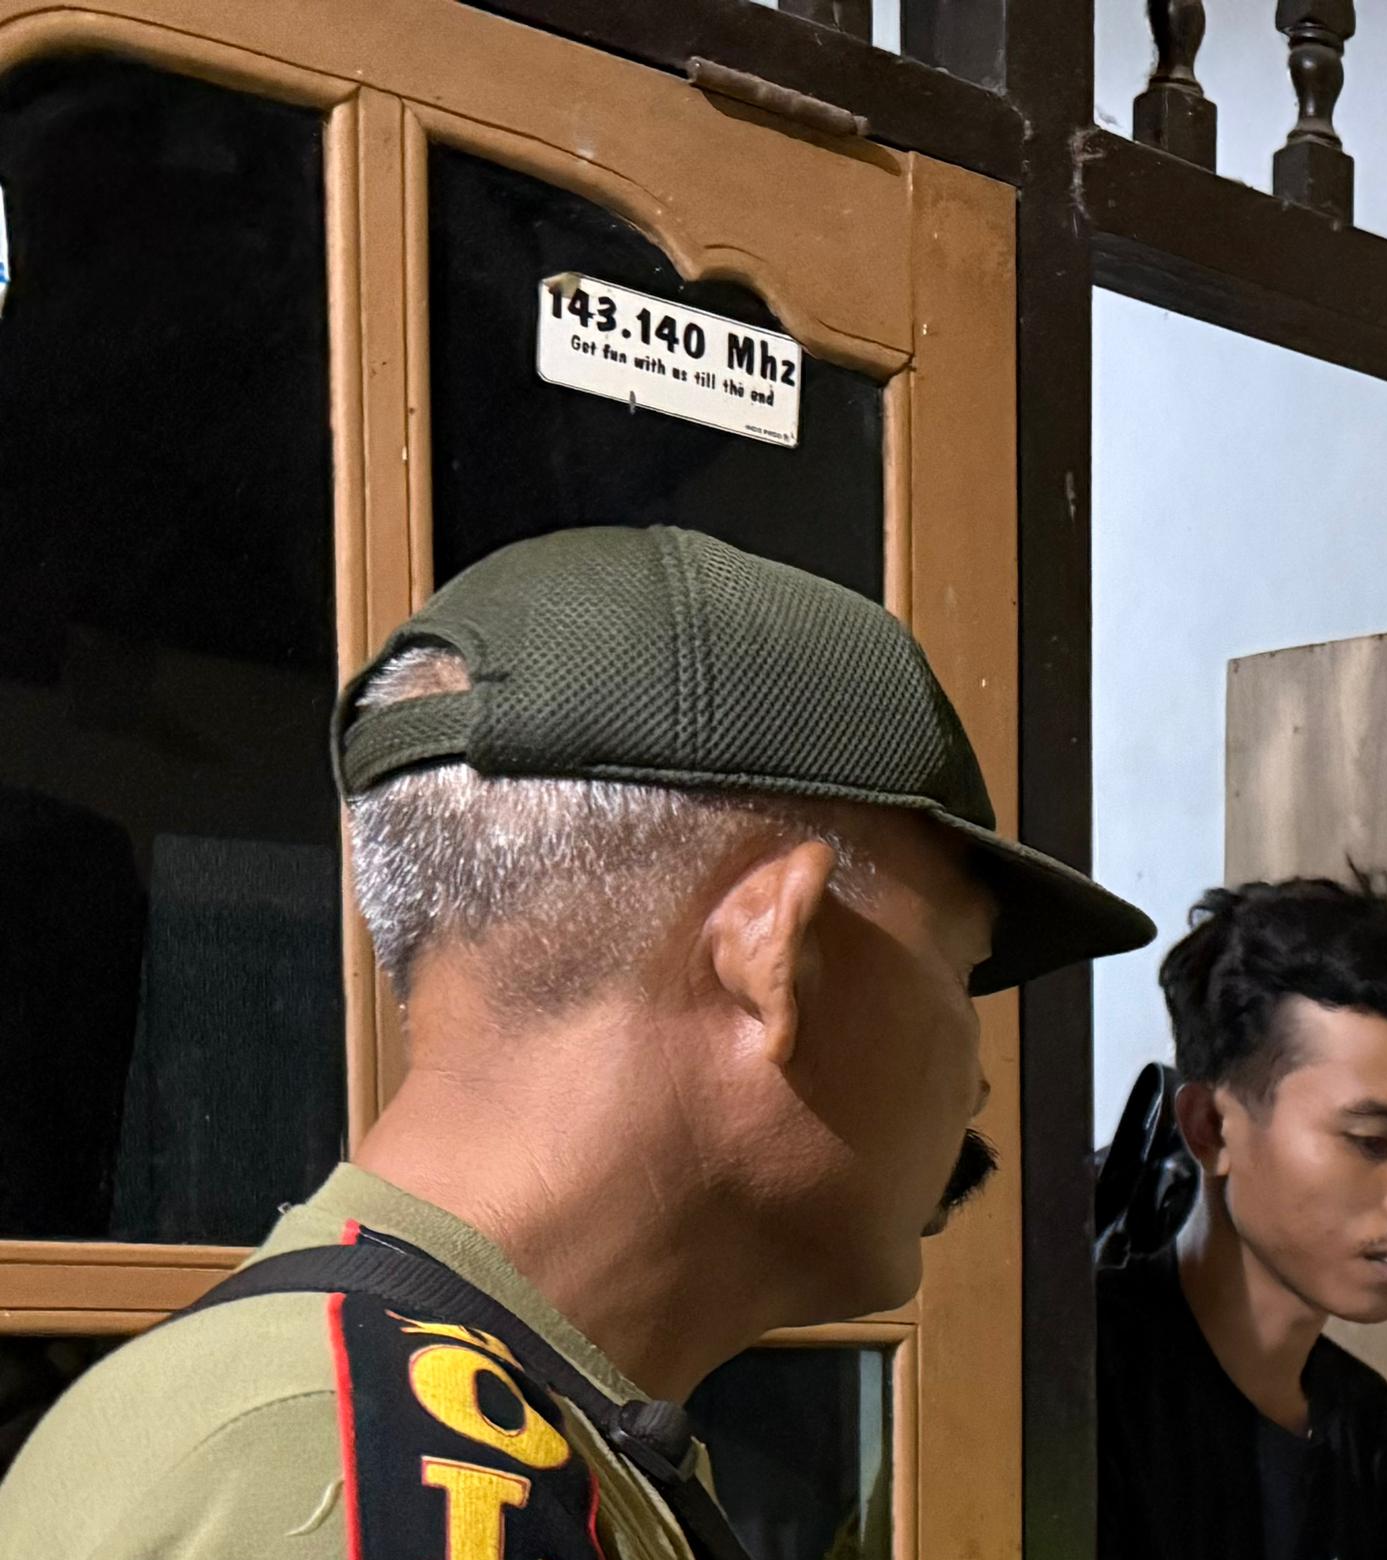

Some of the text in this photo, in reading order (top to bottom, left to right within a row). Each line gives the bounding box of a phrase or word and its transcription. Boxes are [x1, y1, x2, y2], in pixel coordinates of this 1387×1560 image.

[548, 287, 796, 387] 143.140 Mhz
[571, 334, 774, 406] Get fun with us till the end
